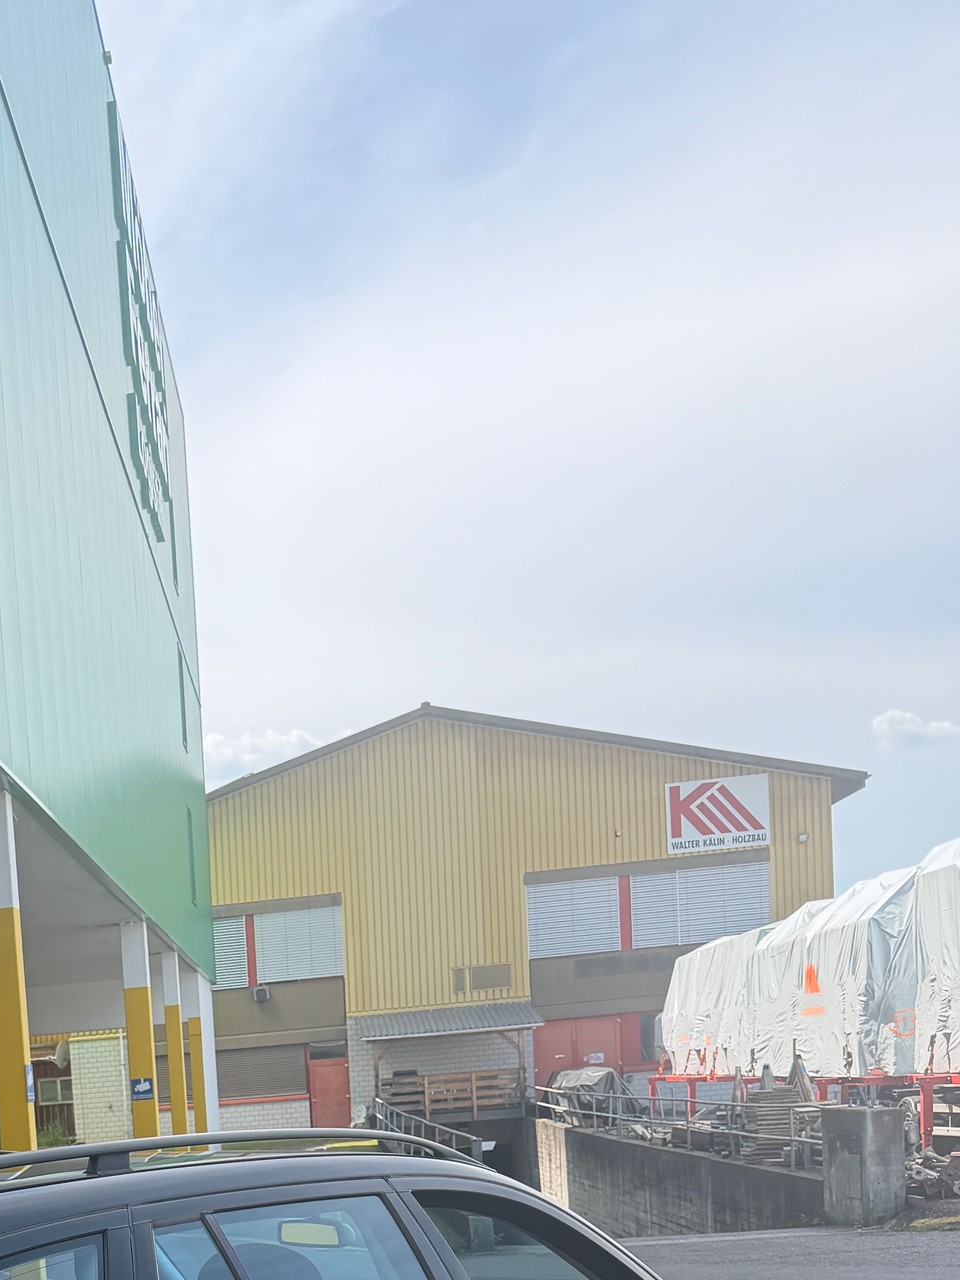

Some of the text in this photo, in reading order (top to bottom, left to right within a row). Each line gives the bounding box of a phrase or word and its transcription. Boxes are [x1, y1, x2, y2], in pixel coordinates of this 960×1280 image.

[671, 833, 767, 850] WALTER KÄLIN HOLZBAU
